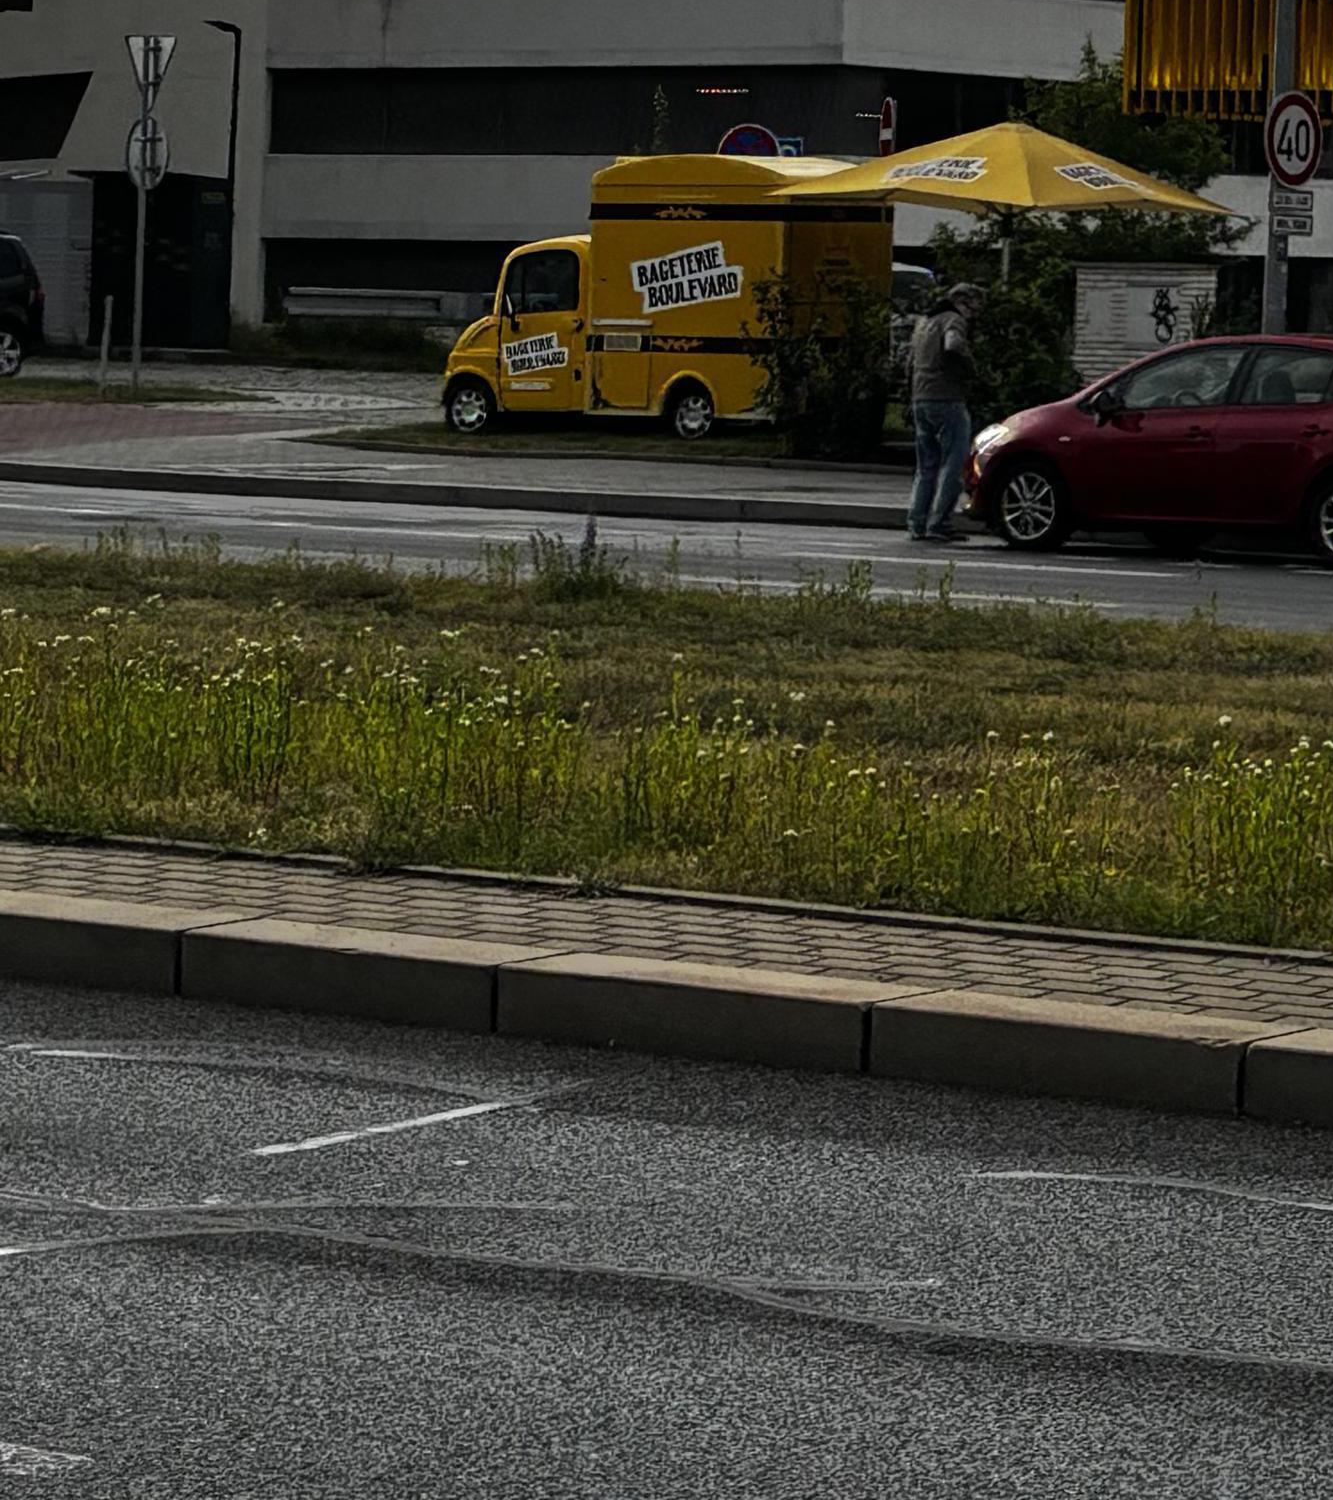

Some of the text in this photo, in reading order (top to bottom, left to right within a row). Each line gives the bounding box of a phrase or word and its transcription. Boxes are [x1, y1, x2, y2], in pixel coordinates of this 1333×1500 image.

[1277, 119, 1310, 161] 40
[637, 246, 722, 287] BAGETERIE
[647, 272, 738, 308] BOULEVARD
